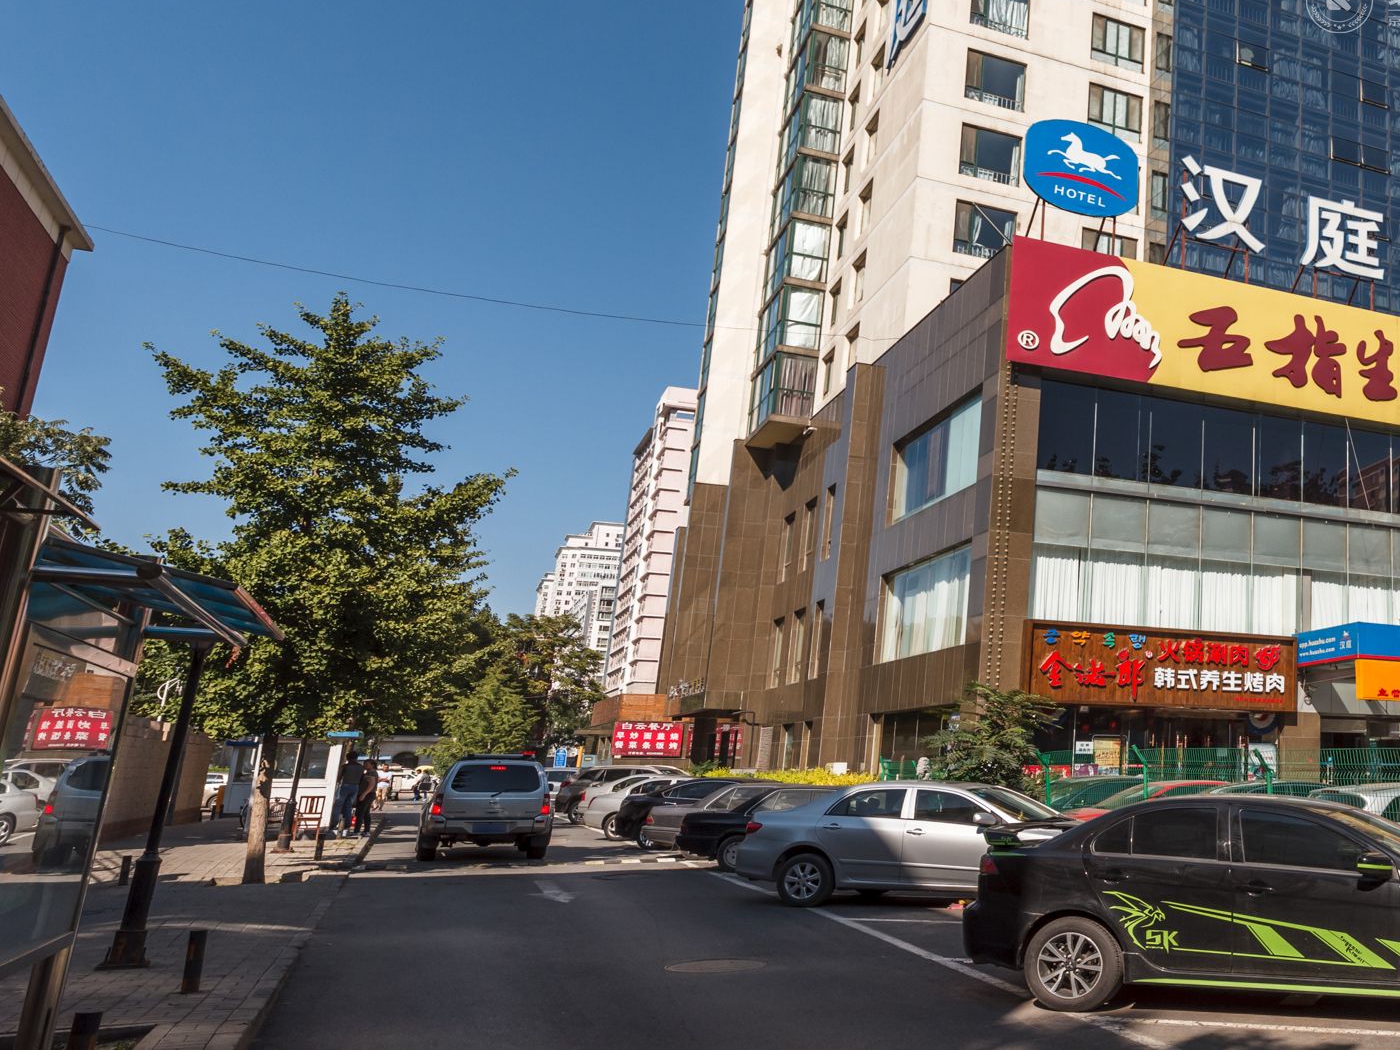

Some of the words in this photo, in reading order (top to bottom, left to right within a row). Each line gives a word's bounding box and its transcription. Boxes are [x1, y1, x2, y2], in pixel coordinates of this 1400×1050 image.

[1053, 184, 1107, 208] HOTEL
[1177, 305, 1399, 402] 五指生
[1157, 638, 1249, 667] 火锅涮肉
[1153, 667, 1286, 693] 韩式养生烤肉
[621, 721, 674, 731] 白云餐厅
